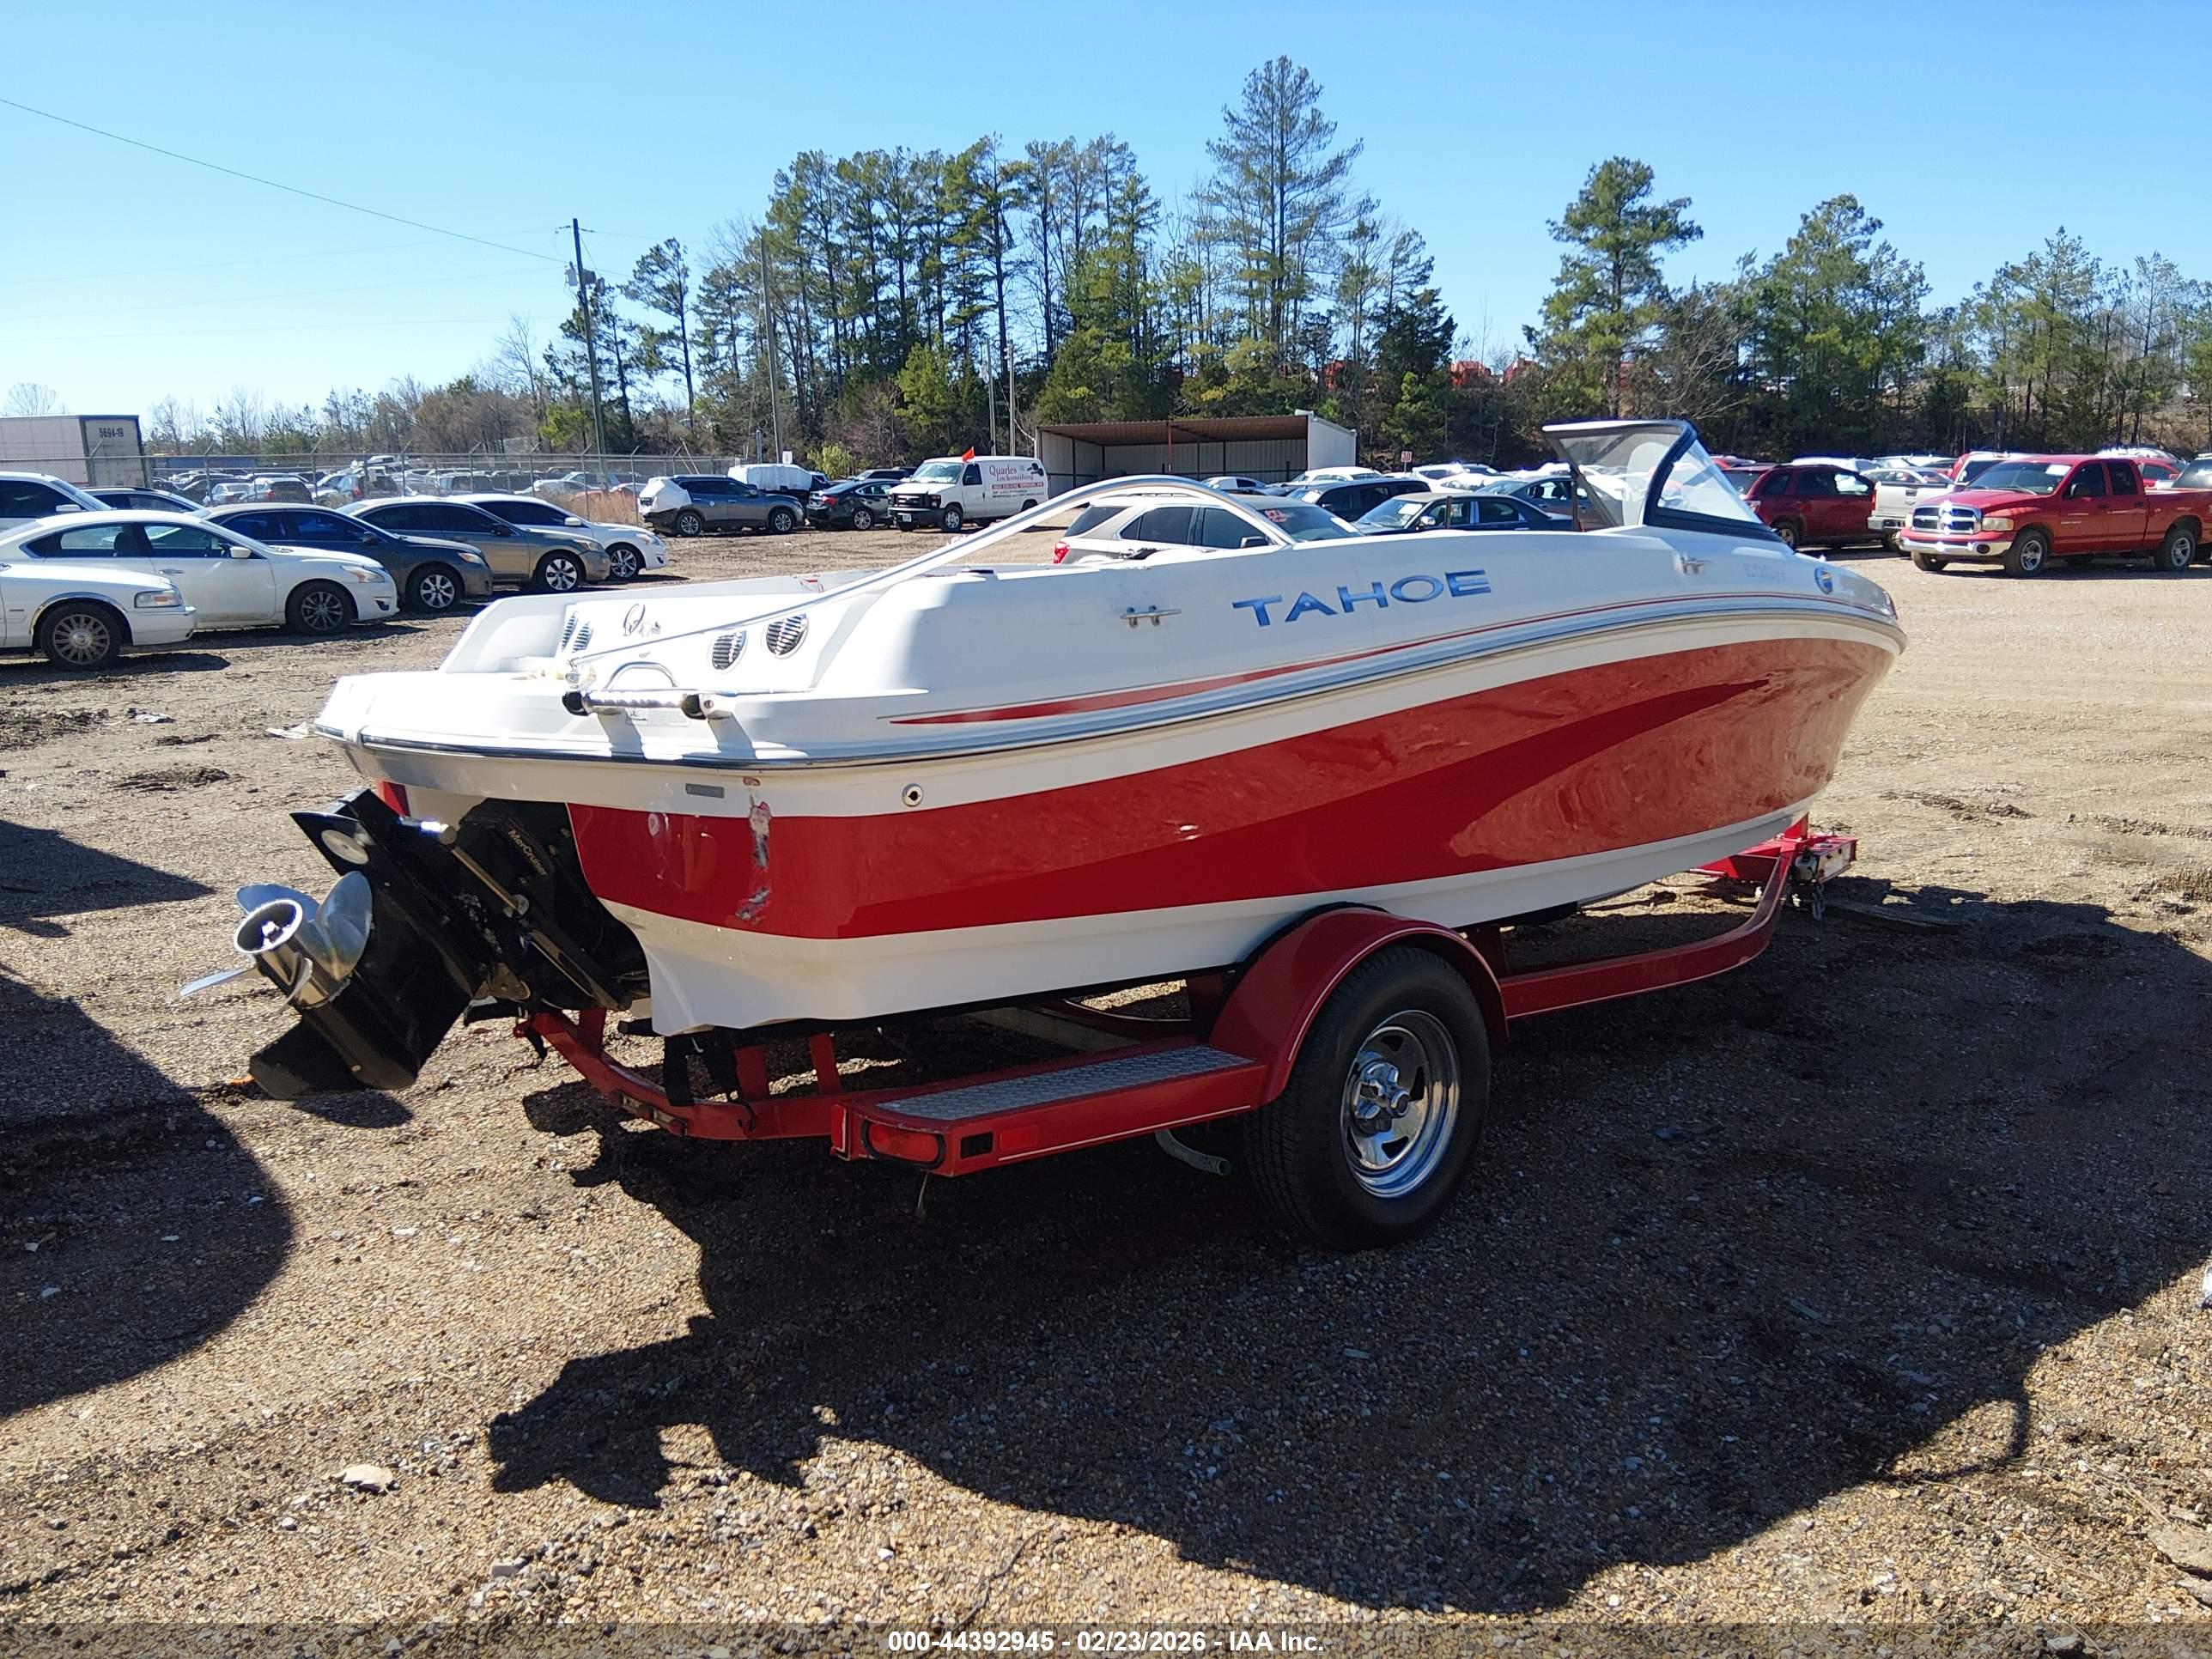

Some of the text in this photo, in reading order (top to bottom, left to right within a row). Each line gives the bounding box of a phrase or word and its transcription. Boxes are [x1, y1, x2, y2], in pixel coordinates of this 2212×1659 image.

[989, 465, 1018, 477] Quarles
[1232, 569, 1492, 627] TAHOE
[507, 830, 548, 875] MerCruiser
